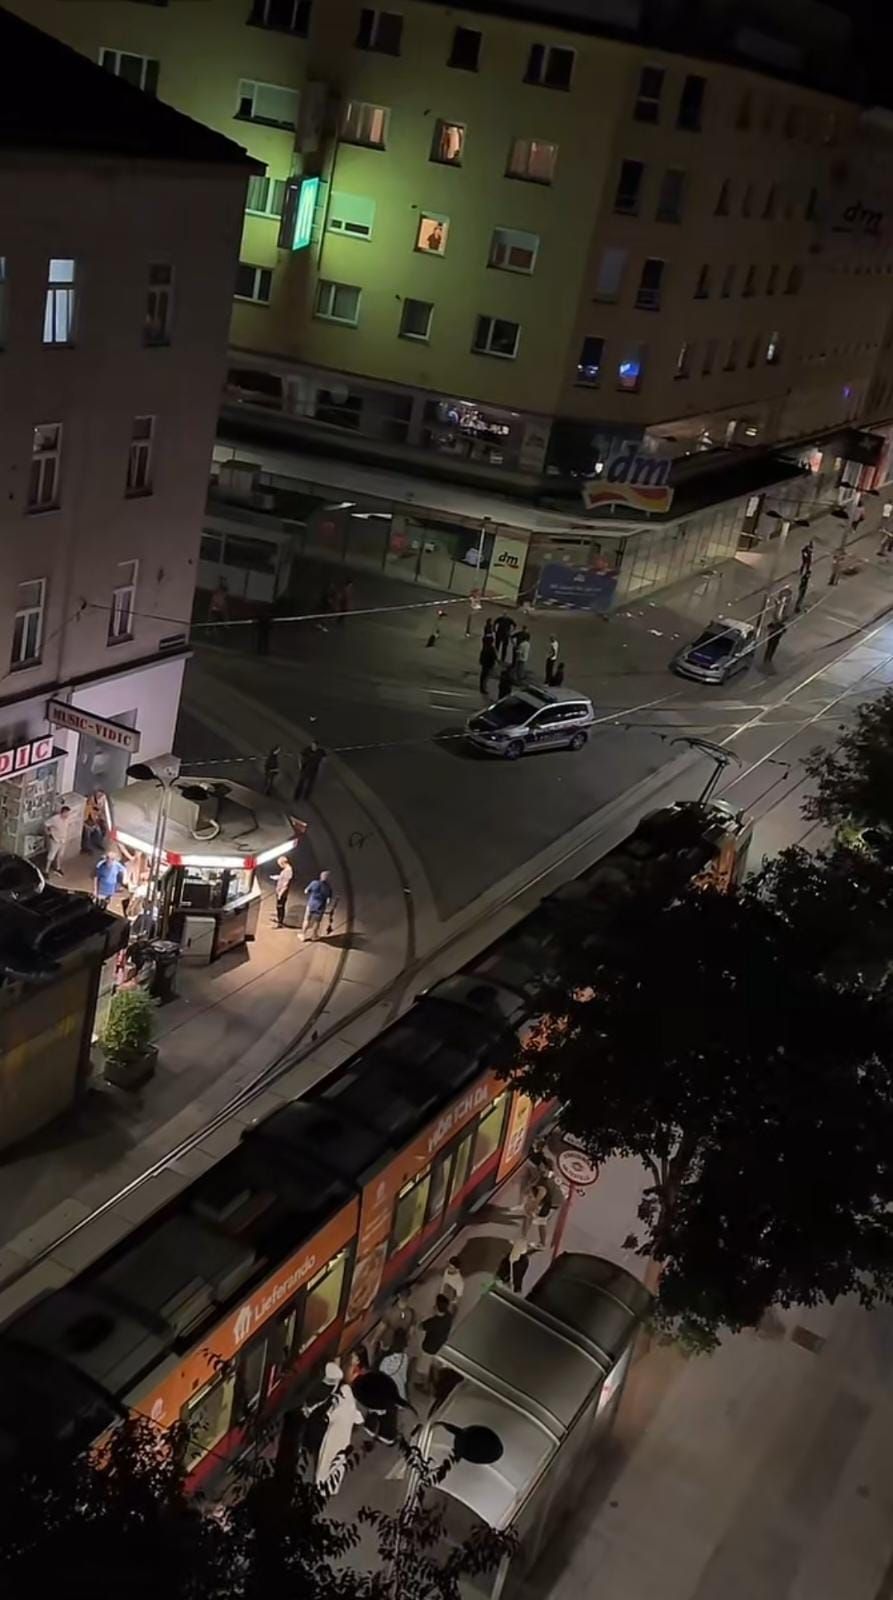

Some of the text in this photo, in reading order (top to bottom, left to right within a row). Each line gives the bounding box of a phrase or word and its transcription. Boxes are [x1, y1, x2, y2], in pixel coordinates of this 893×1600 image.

[607, 444, 670, 485] dm
[498, 551, 519, 566] dm
[53, 707, 132, 746] MUSIC-VIDIC
[255, 1255, 316, 1321] Lieferando
